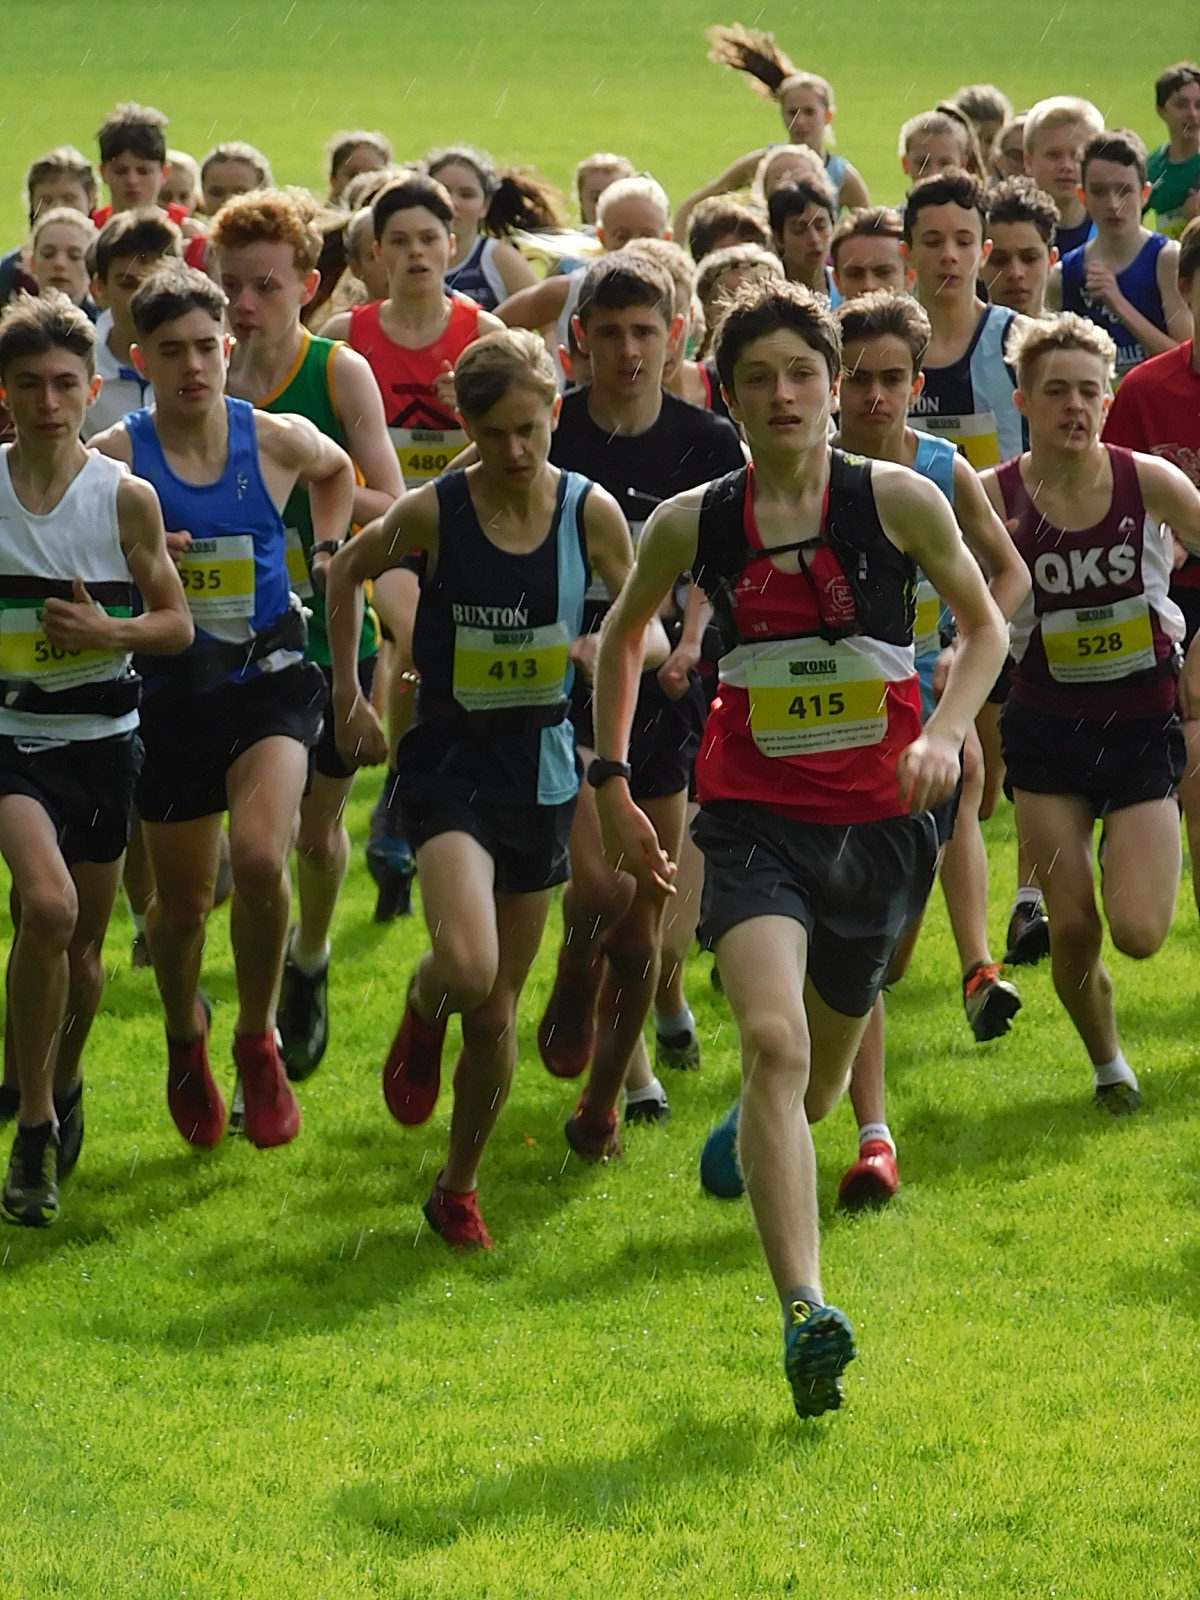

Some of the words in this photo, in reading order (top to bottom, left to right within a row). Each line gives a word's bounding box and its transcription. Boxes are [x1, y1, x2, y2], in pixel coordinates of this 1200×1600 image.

[407, 454, 449, 471] 480
[1034, 544, 1137, 595] QKS
[451, 603, 529, 627] BUXTON
[1077, 632, 1123, 657] 528
[488, 658, 538, 681] 413
[798, 659, 837, 675] KONG
[788, 692, 845, 719] 415
